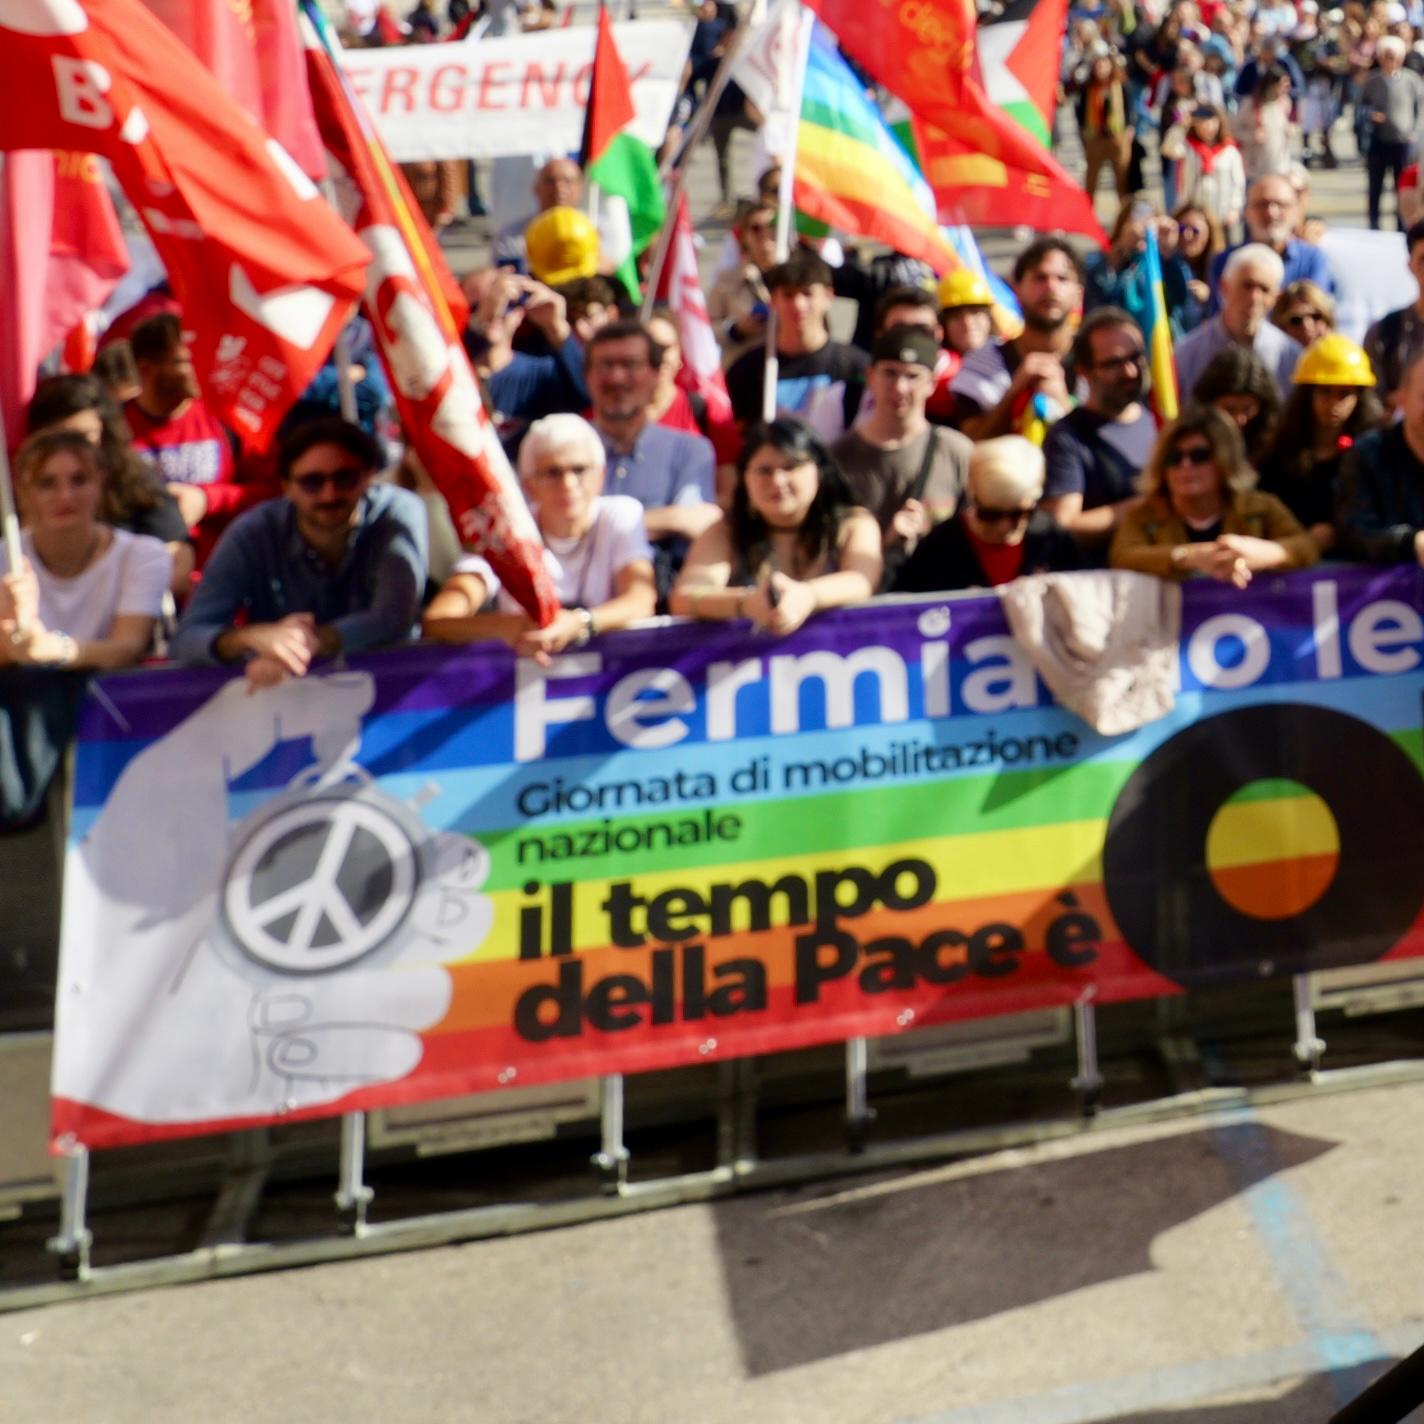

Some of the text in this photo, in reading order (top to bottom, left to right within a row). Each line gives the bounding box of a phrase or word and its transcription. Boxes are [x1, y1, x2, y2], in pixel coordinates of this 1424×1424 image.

[516, 729, 1080, 818] Giornata di mobilitazione
[518, 810, 742, 865] nazionale
[518, 858, 938, 961] il tempo
[513, 889, 1101, 1044] della Pace è
